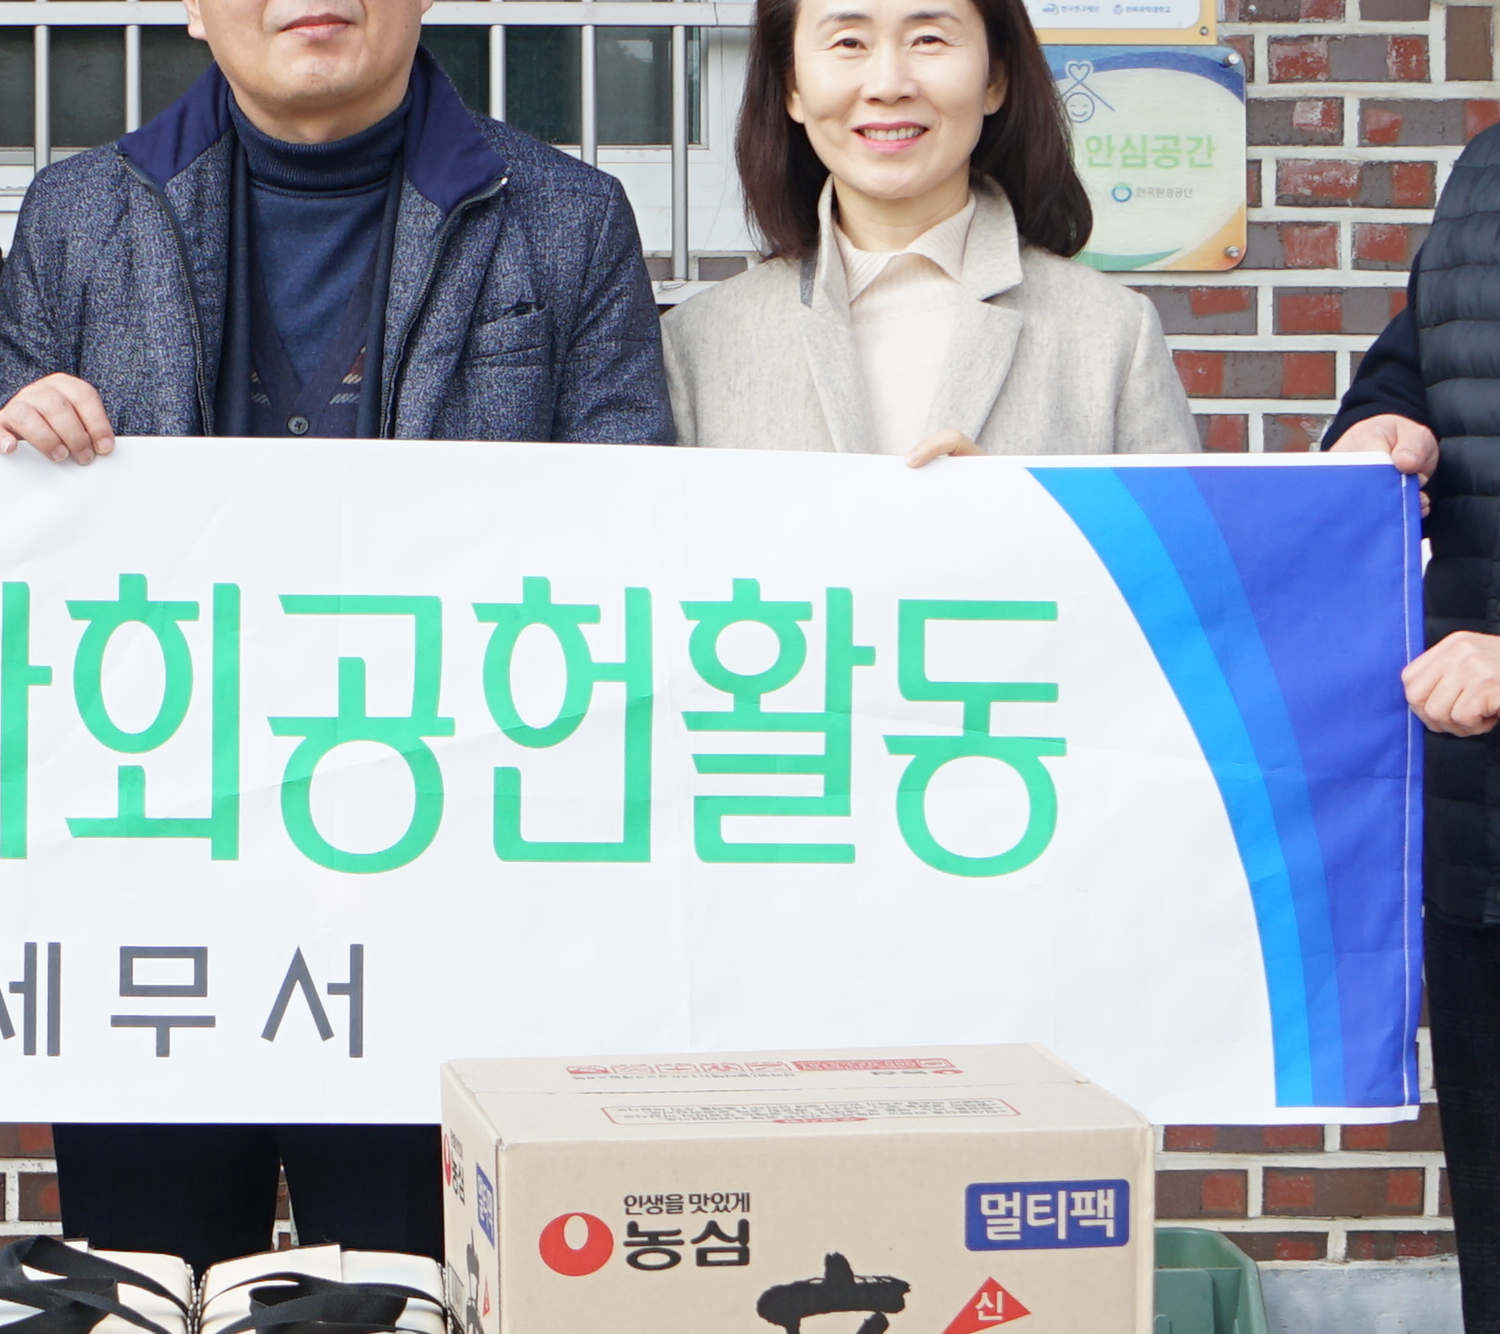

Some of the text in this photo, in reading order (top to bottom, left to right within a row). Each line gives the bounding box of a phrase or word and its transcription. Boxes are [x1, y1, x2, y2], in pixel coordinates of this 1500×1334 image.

[1085, 134, 1217, 169] 안심공간
[623, 1191, 751, 1216] 인생을 맛있게
[979, 1188, 1116, 1241] 멀티팩
[622, 1218, 752, 1272] 농심
[974, 1290, 1005, 1322] 신
